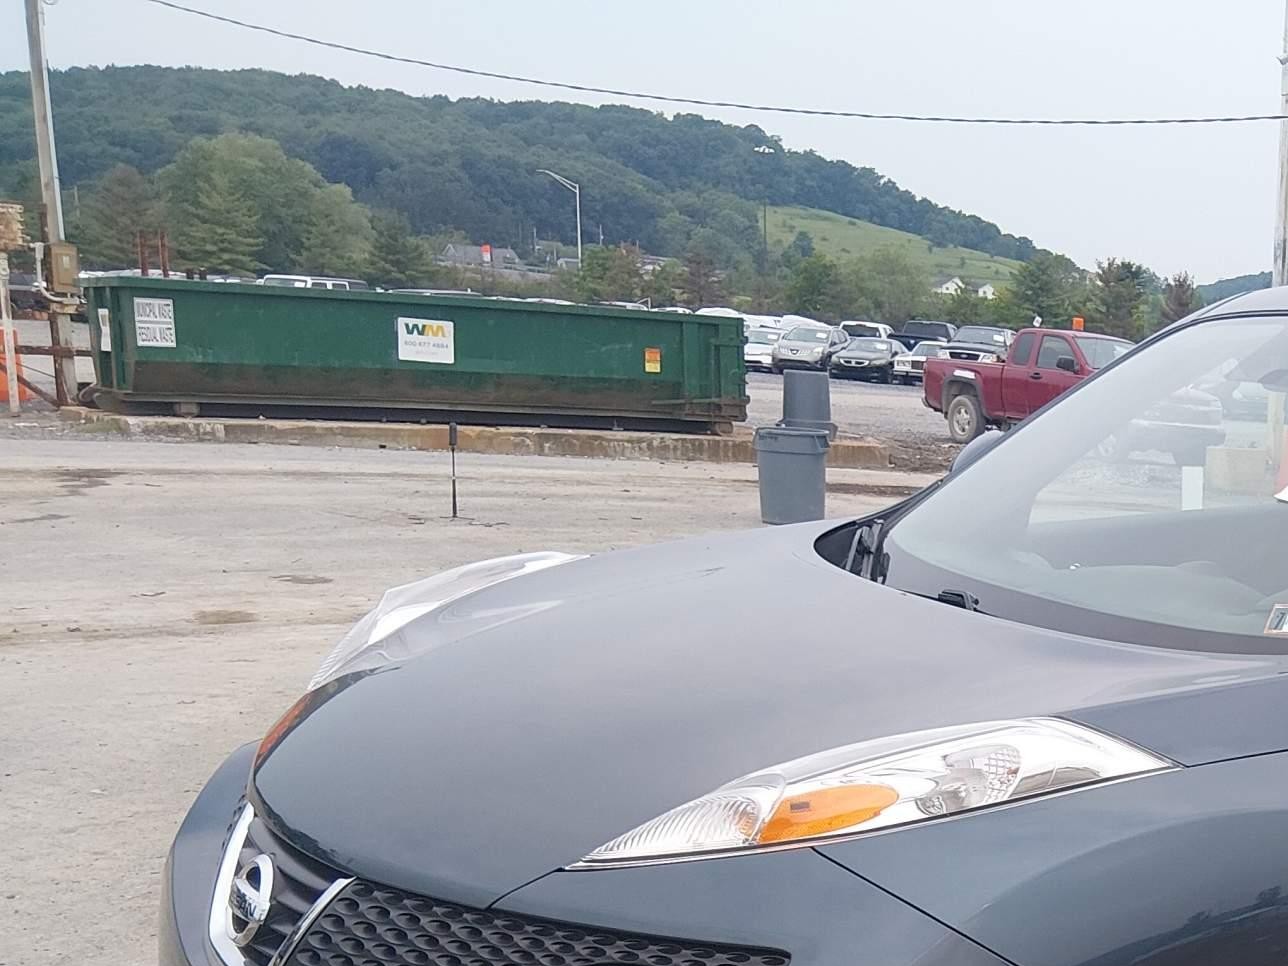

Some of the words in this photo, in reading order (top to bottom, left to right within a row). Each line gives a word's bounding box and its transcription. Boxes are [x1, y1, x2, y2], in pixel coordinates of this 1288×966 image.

[158, 303, 172, 319] WASTE
[160, 327, 174, 343] WASTE
[404, 322, 446, 337] WM
